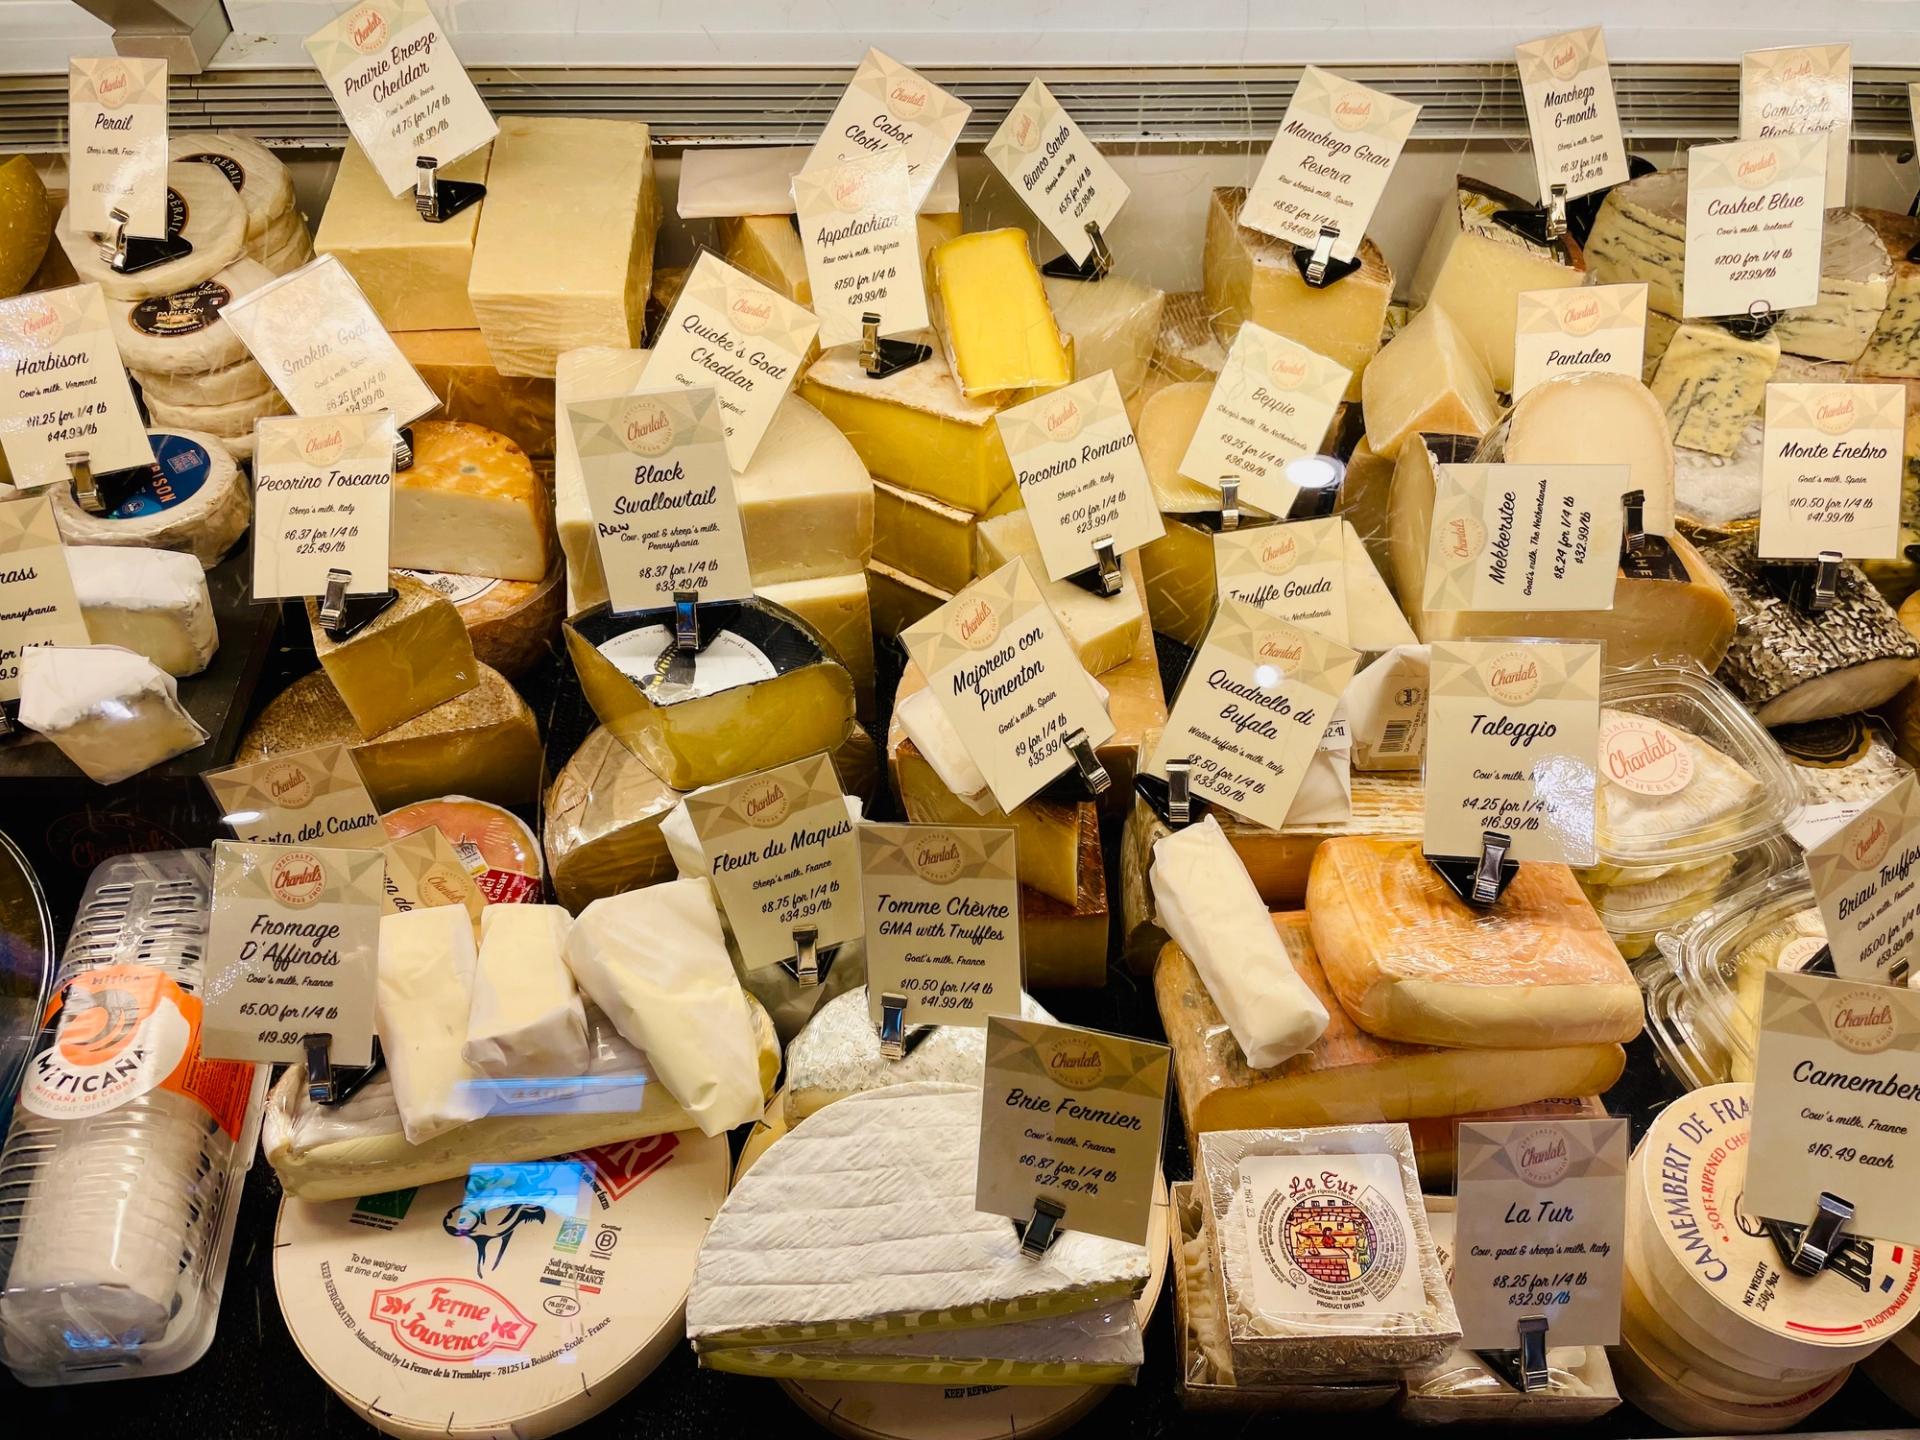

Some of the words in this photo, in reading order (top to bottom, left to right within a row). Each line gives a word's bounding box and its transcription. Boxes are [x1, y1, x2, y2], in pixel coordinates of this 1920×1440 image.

[344, 59, 391, 97] Prairie
[391, 31, 437, 65] Breeze
[372, 61, 430, 104] Cheddar
[1543, 85, 1595, 108] Manchego
[94, 113, 134, 131] Perail
[1554, 103, 1598, 129] 6-month
[872, 114, 913, 145] Cabot
[1283, 119, 1352, 158] Manchego
[1353, 144, 1391, 169] Gran
[1022, 157, 1049, 191] Bianco
[1046, 124, 1071, 159] Sardo
[1299, 155, 1352, 185] Reserva
[1707, 194, 1766, 216] Cashel
[1767, 192, 1805, 211] Blue
[816, 213, 900, 249] Appalachian
[1743, 253, 1760, 268] for
[847, 287, 888, 305] $29.99/lb
[156, 307, 204, 318] PAPILLON
[281, 341, 333, 378] Smokin
[337, 318, 372, 346] Goat
[681, 313, 746, 359] Quicke's
[748, 351, 789, 381] Goat
[1546, 348, 1612, 367] Pantaleo
[15, 351, 90, 377] Harbison
[690, 347, 755, 393] Cheddar
[65, 375, 98, 391] Vermont
[1251, 386, 1296, 418] Beppie
[47, 423, 98, 442] $44.99/lb
[627, 410, 670, 442] Chantal's
[1018, 456, 1078, 490] Pecorino
[1081, 433, 1135, 465] Romano
[1778, 441, 1829, 460] Monte
[1832, 441, 1888, 460] Enebro
[256, 475, 322, 493] Pecorino
[327, 470, 391, 488] Toscano
[634, 460, 685, 485] Black
[613, 485, 717, 516] Swallowtail
[1789, 497, 1825, 509] $10.50
[1060, 507, 1086, 526] $6.00
[1076, 508, 1119, 534] $23.99/lb
[284, 528, 312, 541] $6.37
[598, 522, 630, 538] Raw
[641, 529, 660, 544] goat
[1487, 490, 1517, 585] Mekkerstee
[1574, 511, 1592, 565] $32.99/lb
[296, 541, 346, 555] $25.49/lb
[647, 537, 700, 553] Pennsylvania
[638, 564, 669, 580] $8.37
[668, 563, 686, 581] for
[686, 560, 706, 574] 1/4
[1552, 549, 1568, 580] $8.24
[1283, 576, 1333, 599] Gouda
[952, 644, 1017, 697] Majorero
[1018, 626, 1044, 651] con
[979, 659, 1045, 712] Pimenton
[1206, 668, 1292, 717] Quadrello
[1293, 708, 1317, 727] di
[1219, 703, 1279, 741] Bufala
[1470, 714, 1557, 747] Taleggio
[1188, 752, 1218, 773] $8.50
[1609, 729, 1677, 779] Chantal's
[1193, 773, 1246, 803] $33.99/lb
[1462, 797, 1499, 812] $4.25
[1499, 798, 1521, 817] for
[297, 820, 324, 843] del
[326, 813, 378, 834] Casar
[1480, 815, 1540, 831] $16.99/lb
[712, 850, 759, 876] Fleur
[762, 839, 787, 860] du
[790, 819, 854, 852] Maquis
[274, 864, 322, 889] Chantal's
[805, 860, 833, 874] France
[481, 878, 497, 893] del
[487, 873, 510, 901] Casar
[1838, 880, 1878, 921] Briau
[1879, 844, 1920, 889] Truffes
[761, 898, 790, 915] $8.75
[791, 893, 809, 911] for
[779, 898, 832, 925] $34.99/lb
[877, 893, 942, 916] Tomme
[946, 896, 1010, 919] Chèvre
[250, 914, 341, 948] Fromage
[878, 920, 913, 936] GMA
[915, 921, 946, 939] with
[949, 923, 1005, 946] Truffles
[239, 940, 341, 972] D'Affinois
[904, 953, 932, 964] Goat's
[956, 955, 986, 967] France
[246, 973, 274, 985] Cow's
[301, 977, 334, 988] France
[900, 978, 939, 993] $10.50
[239, 1003, 279, 1017] $5.00
[279, 1004, 300, 1022] for
[300, 1005, 323, 1020] 1/4
[920, 995, 975, 1010] $41.99/lb
[36, 1049, 146, 1094] MITICAÑA
[1005, 1087, 1052, 1114] Brie
[1055, 1097, 1143, 1131] Fermier
[1800, 1107, 1834, 1123] Cow's
[1867, 1118, 1908, 1136] France
[1677, 1111, 1714, 1146] DE
[1081, 1139, 1117, 1155] France
[1807, 1142, 1857, 1162] $16.49
[1858, 1153, 1895, 1169] each
[1018, 1153, 1055, 1170] $6.87
[1288, 1175, 1316, 1199] La
[1320, 1170, 1358, 1196] Tur
[1700, 1146, 1727, 1231] SOFT-RIPENED
[596, 1190, 611, 1211] farm
[1503, 1201, 1532, 1224] La
[1536, 1199, 1575, 1224] Tur
[1661, 1142, 1729, 1284] CAMEMBERT
[350, 1252, 360, 1262] To
[360, 1256, 372, 1265] be
[1494, 1246, 1518, 1261] goat
[344, 1264, 353, 1273] at
[354, 1266, 371, 1277] time
[371, 1270, 382, 1279] of
[381, 1273, 399, 1282] sale
[543, 1265, 569, 1278] Product
[575, 1271, 605, 1286] FRANCE
[1491, 1273, 1528, 1289] $8.25
[1528, 1273, 1550, 1293] for
[1551, 1272, 1575, 1286] 1/4
[1748, 1260, 1769, 1294] WEIGHT
[427, 1286, 491, 1321] Ferme
[1508, 1290, 1571, 1306] $32.99/lb
[1742, 1287, 1756, 1308] NET
[1754, 1271, 1781, 1313] 250g/9oz
[400, 1312, 491, 1352] Jouvence
[354, 1328, 395, 1364] Manufactured
[391, 1353, 401, 1367] by
[399, 1358, 411, 1369] La
[409, 1361, 433, 1376] Ferme
[432, 1366, 443, 1377] de
[450, 1369, 492, 1381] Tremblaye
[497, 1363, 521, 1377] 78125
[520, 1361, 531, 1371] La
[586, 1316, 612, 1337] France
[943, 1386, 967, 1400] KEEP
